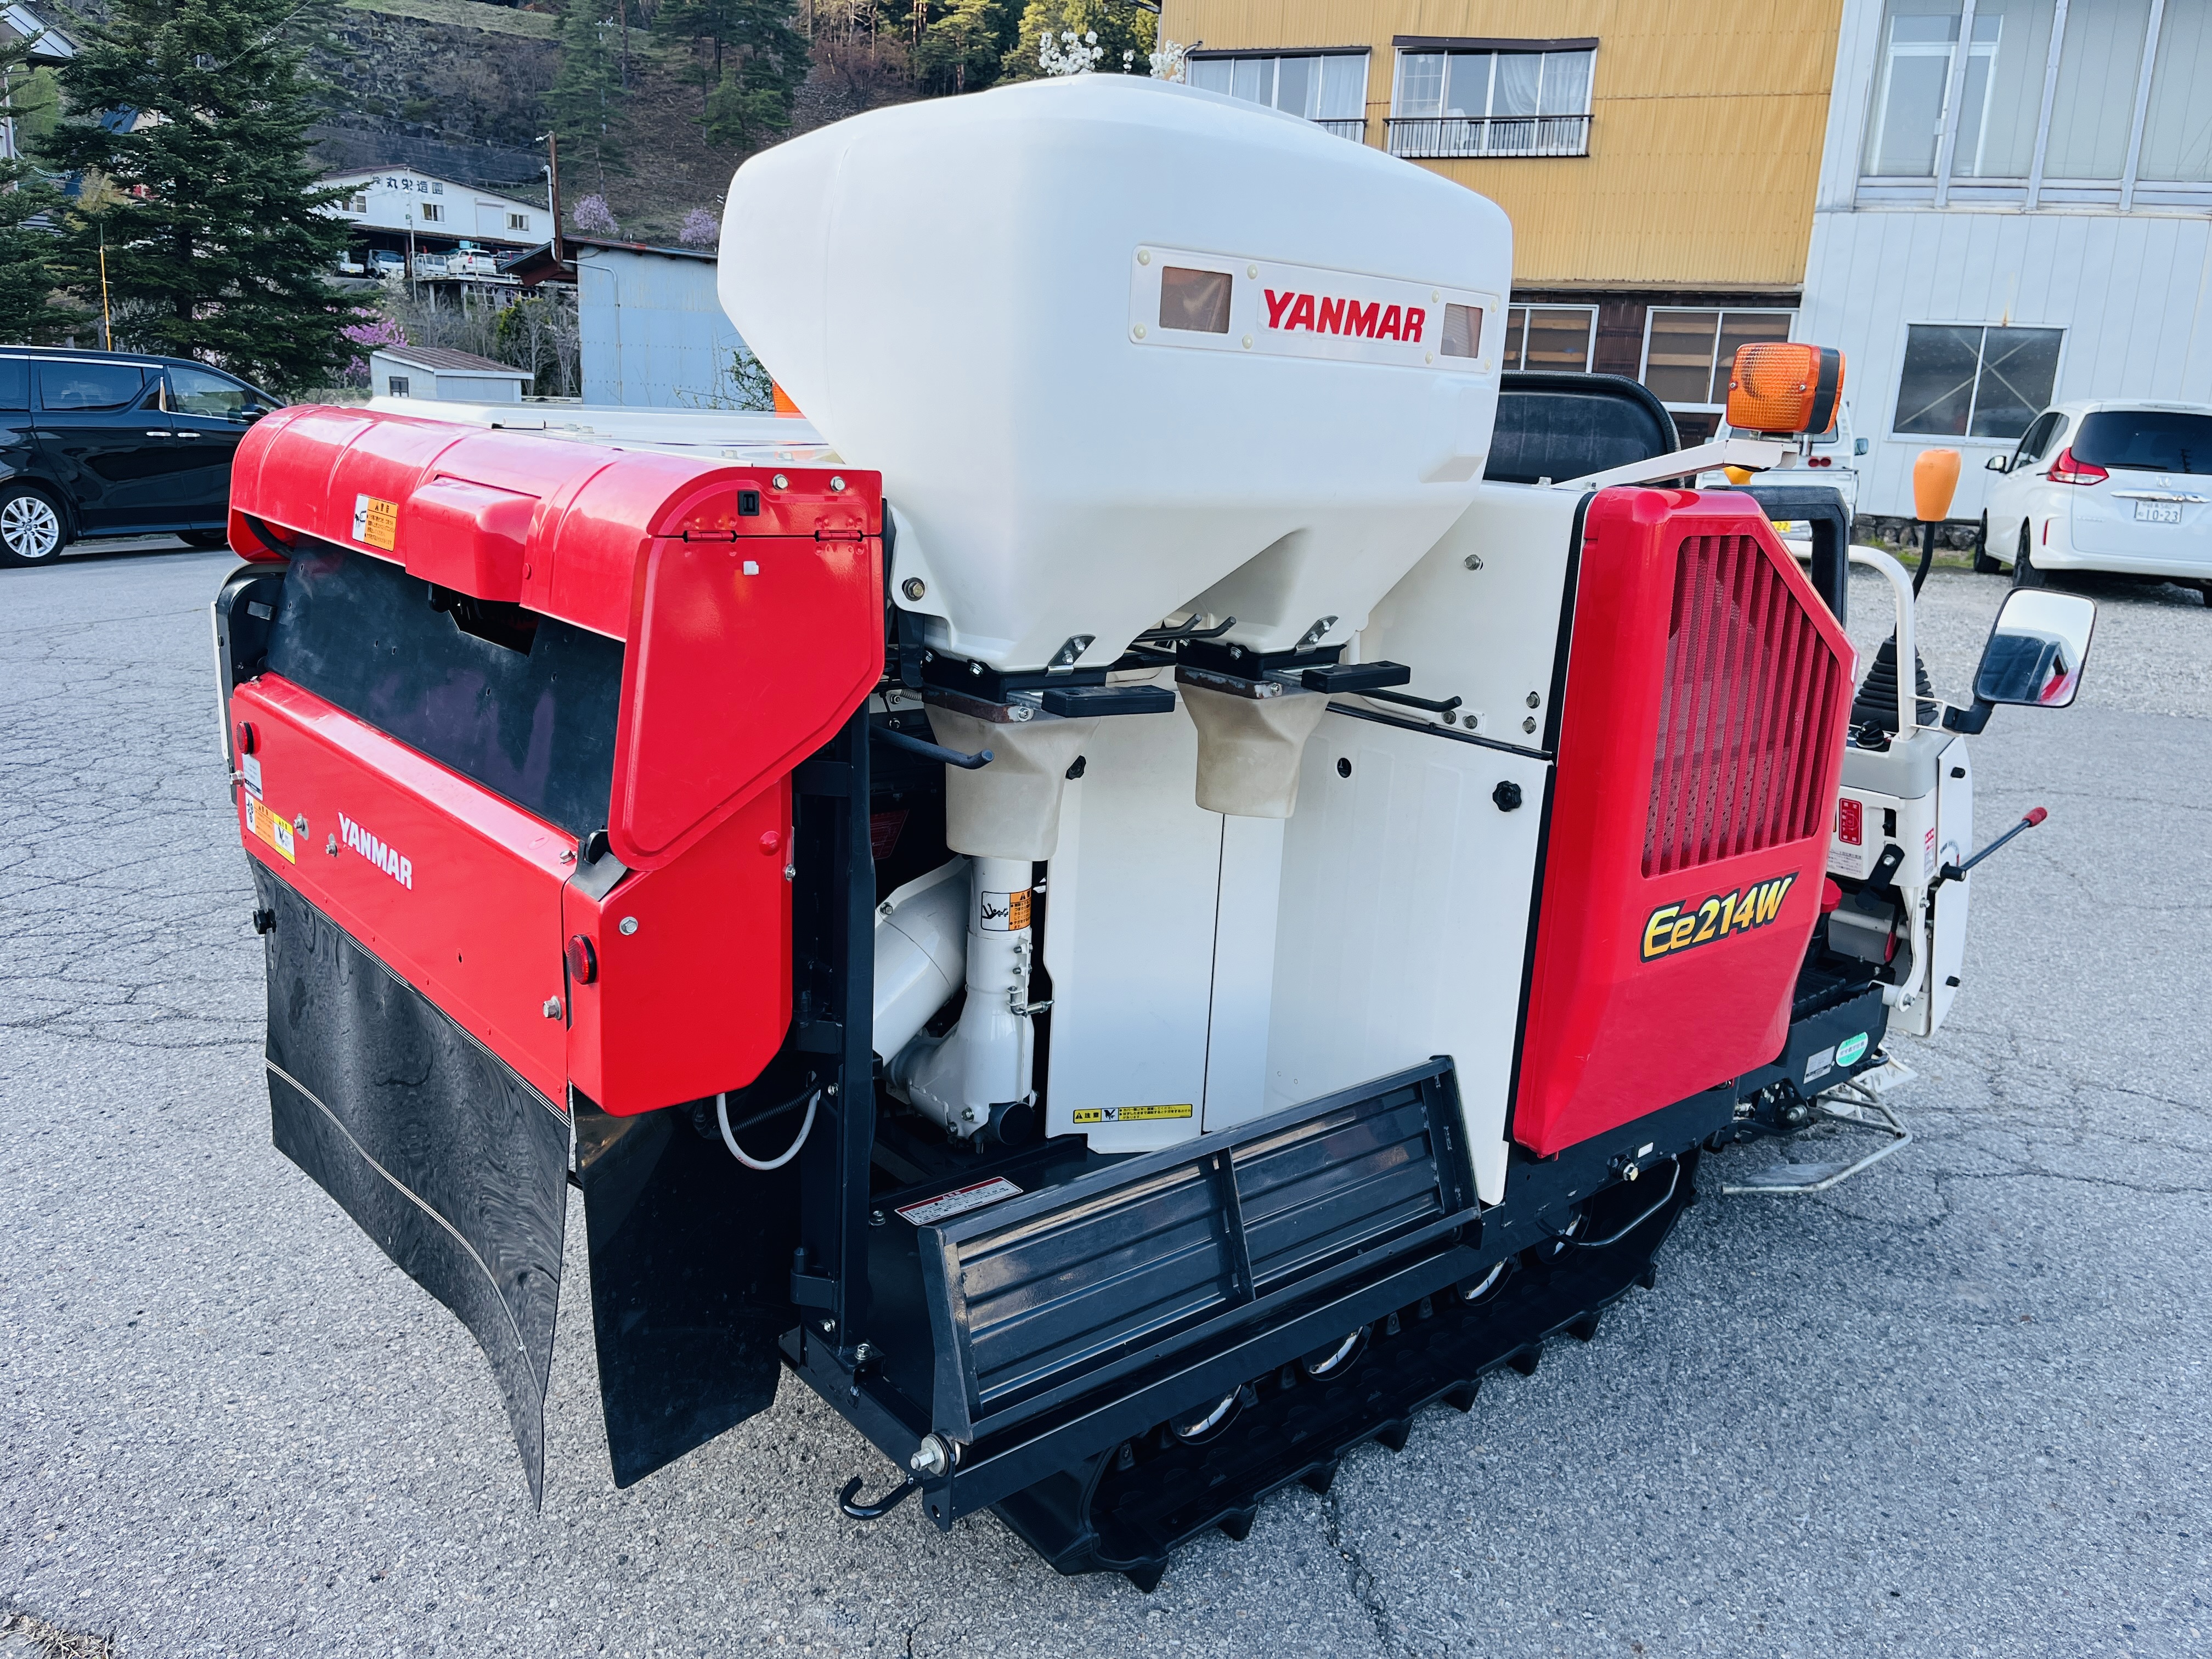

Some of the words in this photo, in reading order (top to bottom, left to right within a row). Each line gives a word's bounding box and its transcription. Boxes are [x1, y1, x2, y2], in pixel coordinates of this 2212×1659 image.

[1263, 289, 1426, 343] YANMAR
[337, 812, 412, 890] YANMAR
[1644, 877, 1792, 957] Ee214W
